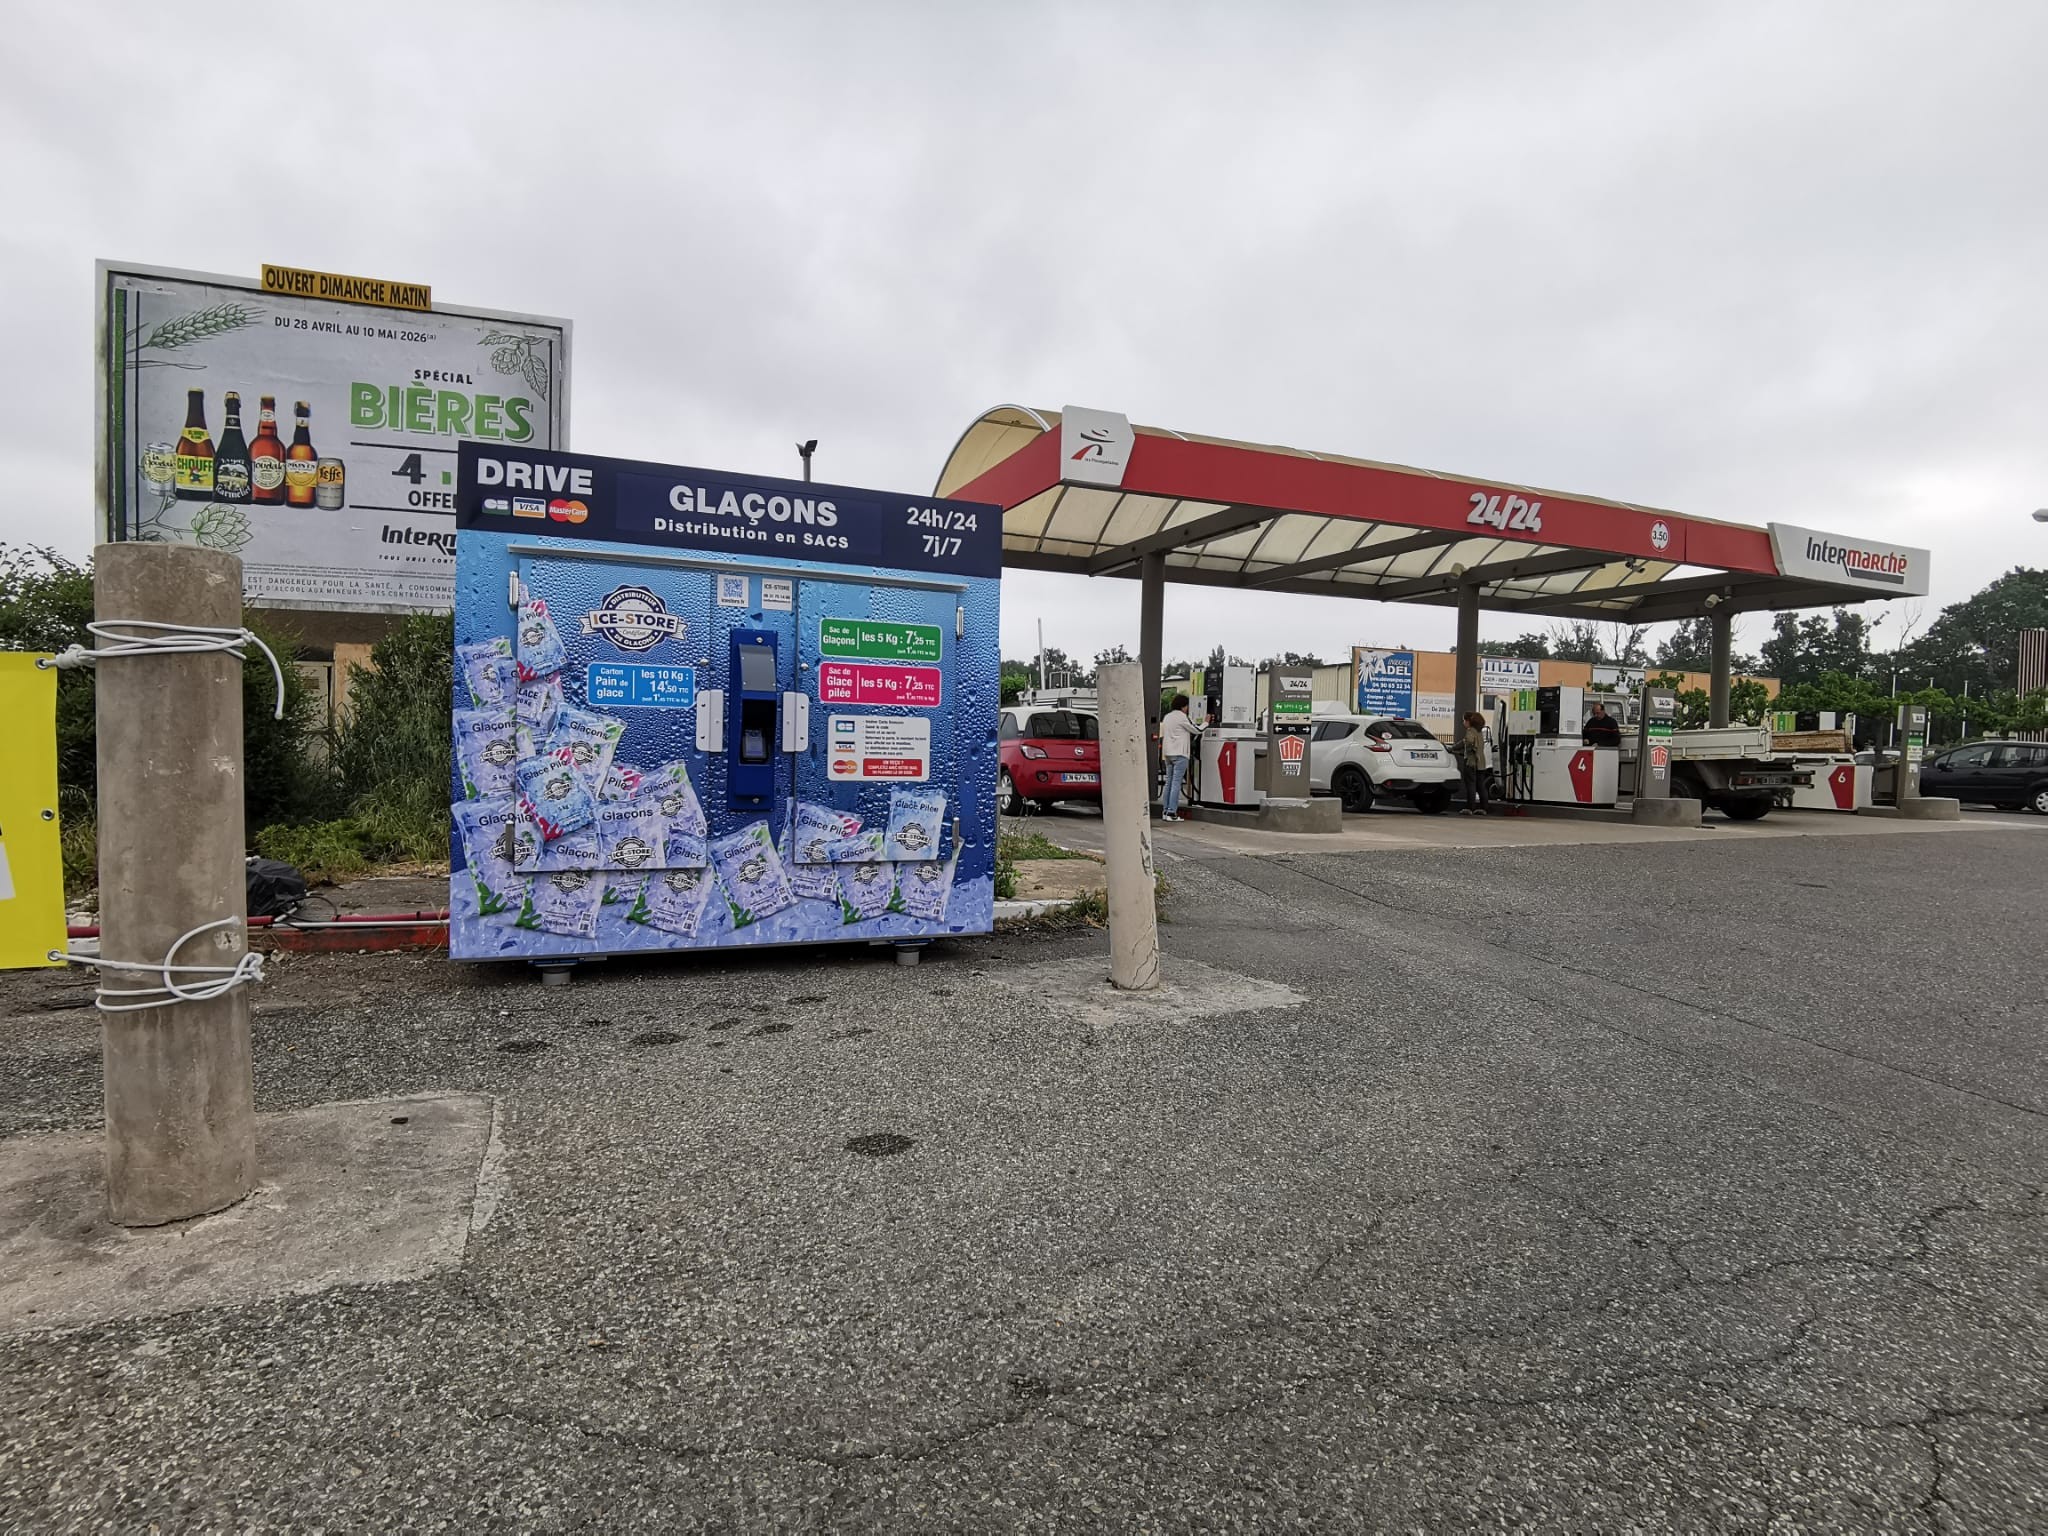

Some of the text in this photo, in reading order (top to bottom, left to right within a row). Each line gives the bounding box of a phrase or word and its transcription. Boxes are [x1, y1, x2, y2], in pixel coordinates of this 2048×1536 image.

[265, 268, 428, 307] OUVERT DIMANCHE MATIN
[275, 316, 290, 328] DU
[294, 318, 308, 330] 28
[311, 320, 342, 334] AVRIL
[345, 325, 360, 336] AU
[363, 327, 374, 337] 10
[378, 329, 397, 340] MAI
[414, 369, 473, 385] SPÉCIAL
[350, 380, 535, 443] BIÈRES
[391, 453, 427, 485] 4
[477, 457, 593, 495] DRIVE
[519, 503, 540, 512] VISA
[669, 485, 838, 527] GLAÇONS
[1467, 492, 1543, 533] 24/24
[906, 507, 978, 532] 24h/24
[654, 518, 849, 549] Distribution en SACS
[922, 535, 962, 558] 7j/7
[1806, 537, 1908, 577] Intermarché
[268, 577, 317, 586] DANGEREUX
[610, 591, 657, 606] DISTRIBUTEUR
[593, 613, 676, 630] ICE-STORE
[823, 635, 856, 646] Glaçons
[862, 632, 876, 642] les
[877, 633, 884, 643] 5
[885, 634, 898, 645] Kg
[1375, 658, 1411, 675] ADEL
[1485, 661, 1534, 674] MITA
[595, 676, 617, 686] Pain
[641, 669, 655, 679] les
[658, 670, 669, 679] 10
[671, 671, 684, 681] Kg
[827, 676, 852, 686] Glace
[861, 678, 875, 687] les
[876, 679, 883, 688] 5
[885, 679, 897, 690] Kg
[597, 688, 624, 698] glace
[828, 688, 851, 699] pilée
[472, 720, 516, 733] Glaçons
[570, 720, 609, 740] Glaçons
[1225, 750, 1231, 767] 1
[1577, 757, 1587, 772] 4
[523, 765, 548, 781] Glace
[1838, 772, 1846, 783] 6
[801, 815, 828, 831] Glace
[613, 848, 650, 858] ICE-STORE
[724, 841, 762, 859] Glaçons
